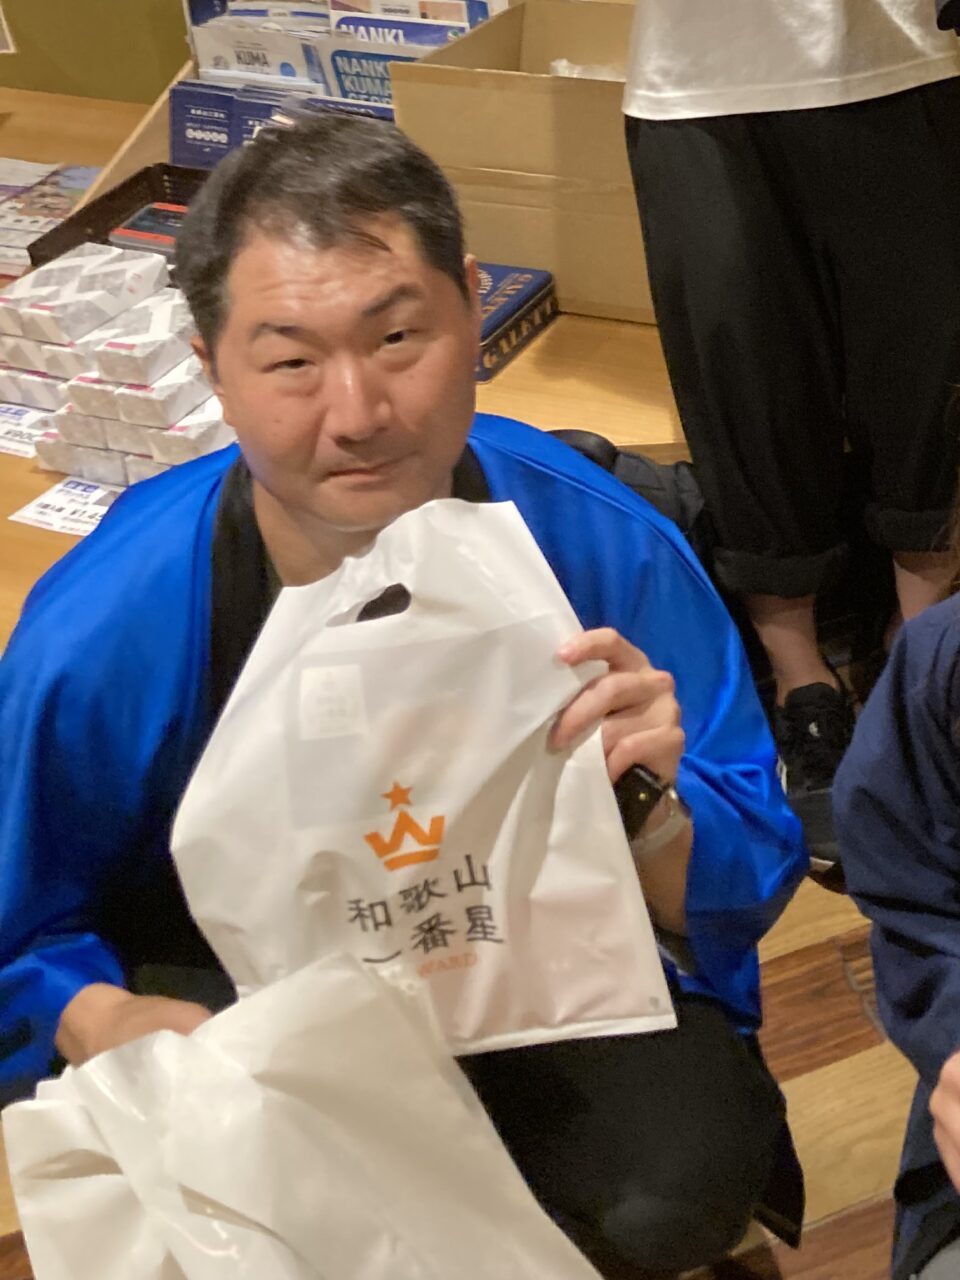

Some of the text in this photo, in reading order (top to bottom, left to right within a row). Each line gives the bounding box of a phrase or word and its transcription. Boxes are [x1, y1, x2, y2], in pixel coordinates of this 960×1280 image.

[347, 854, 492, 932] 和歌山
[362, 905, 504, 964] 一番星
